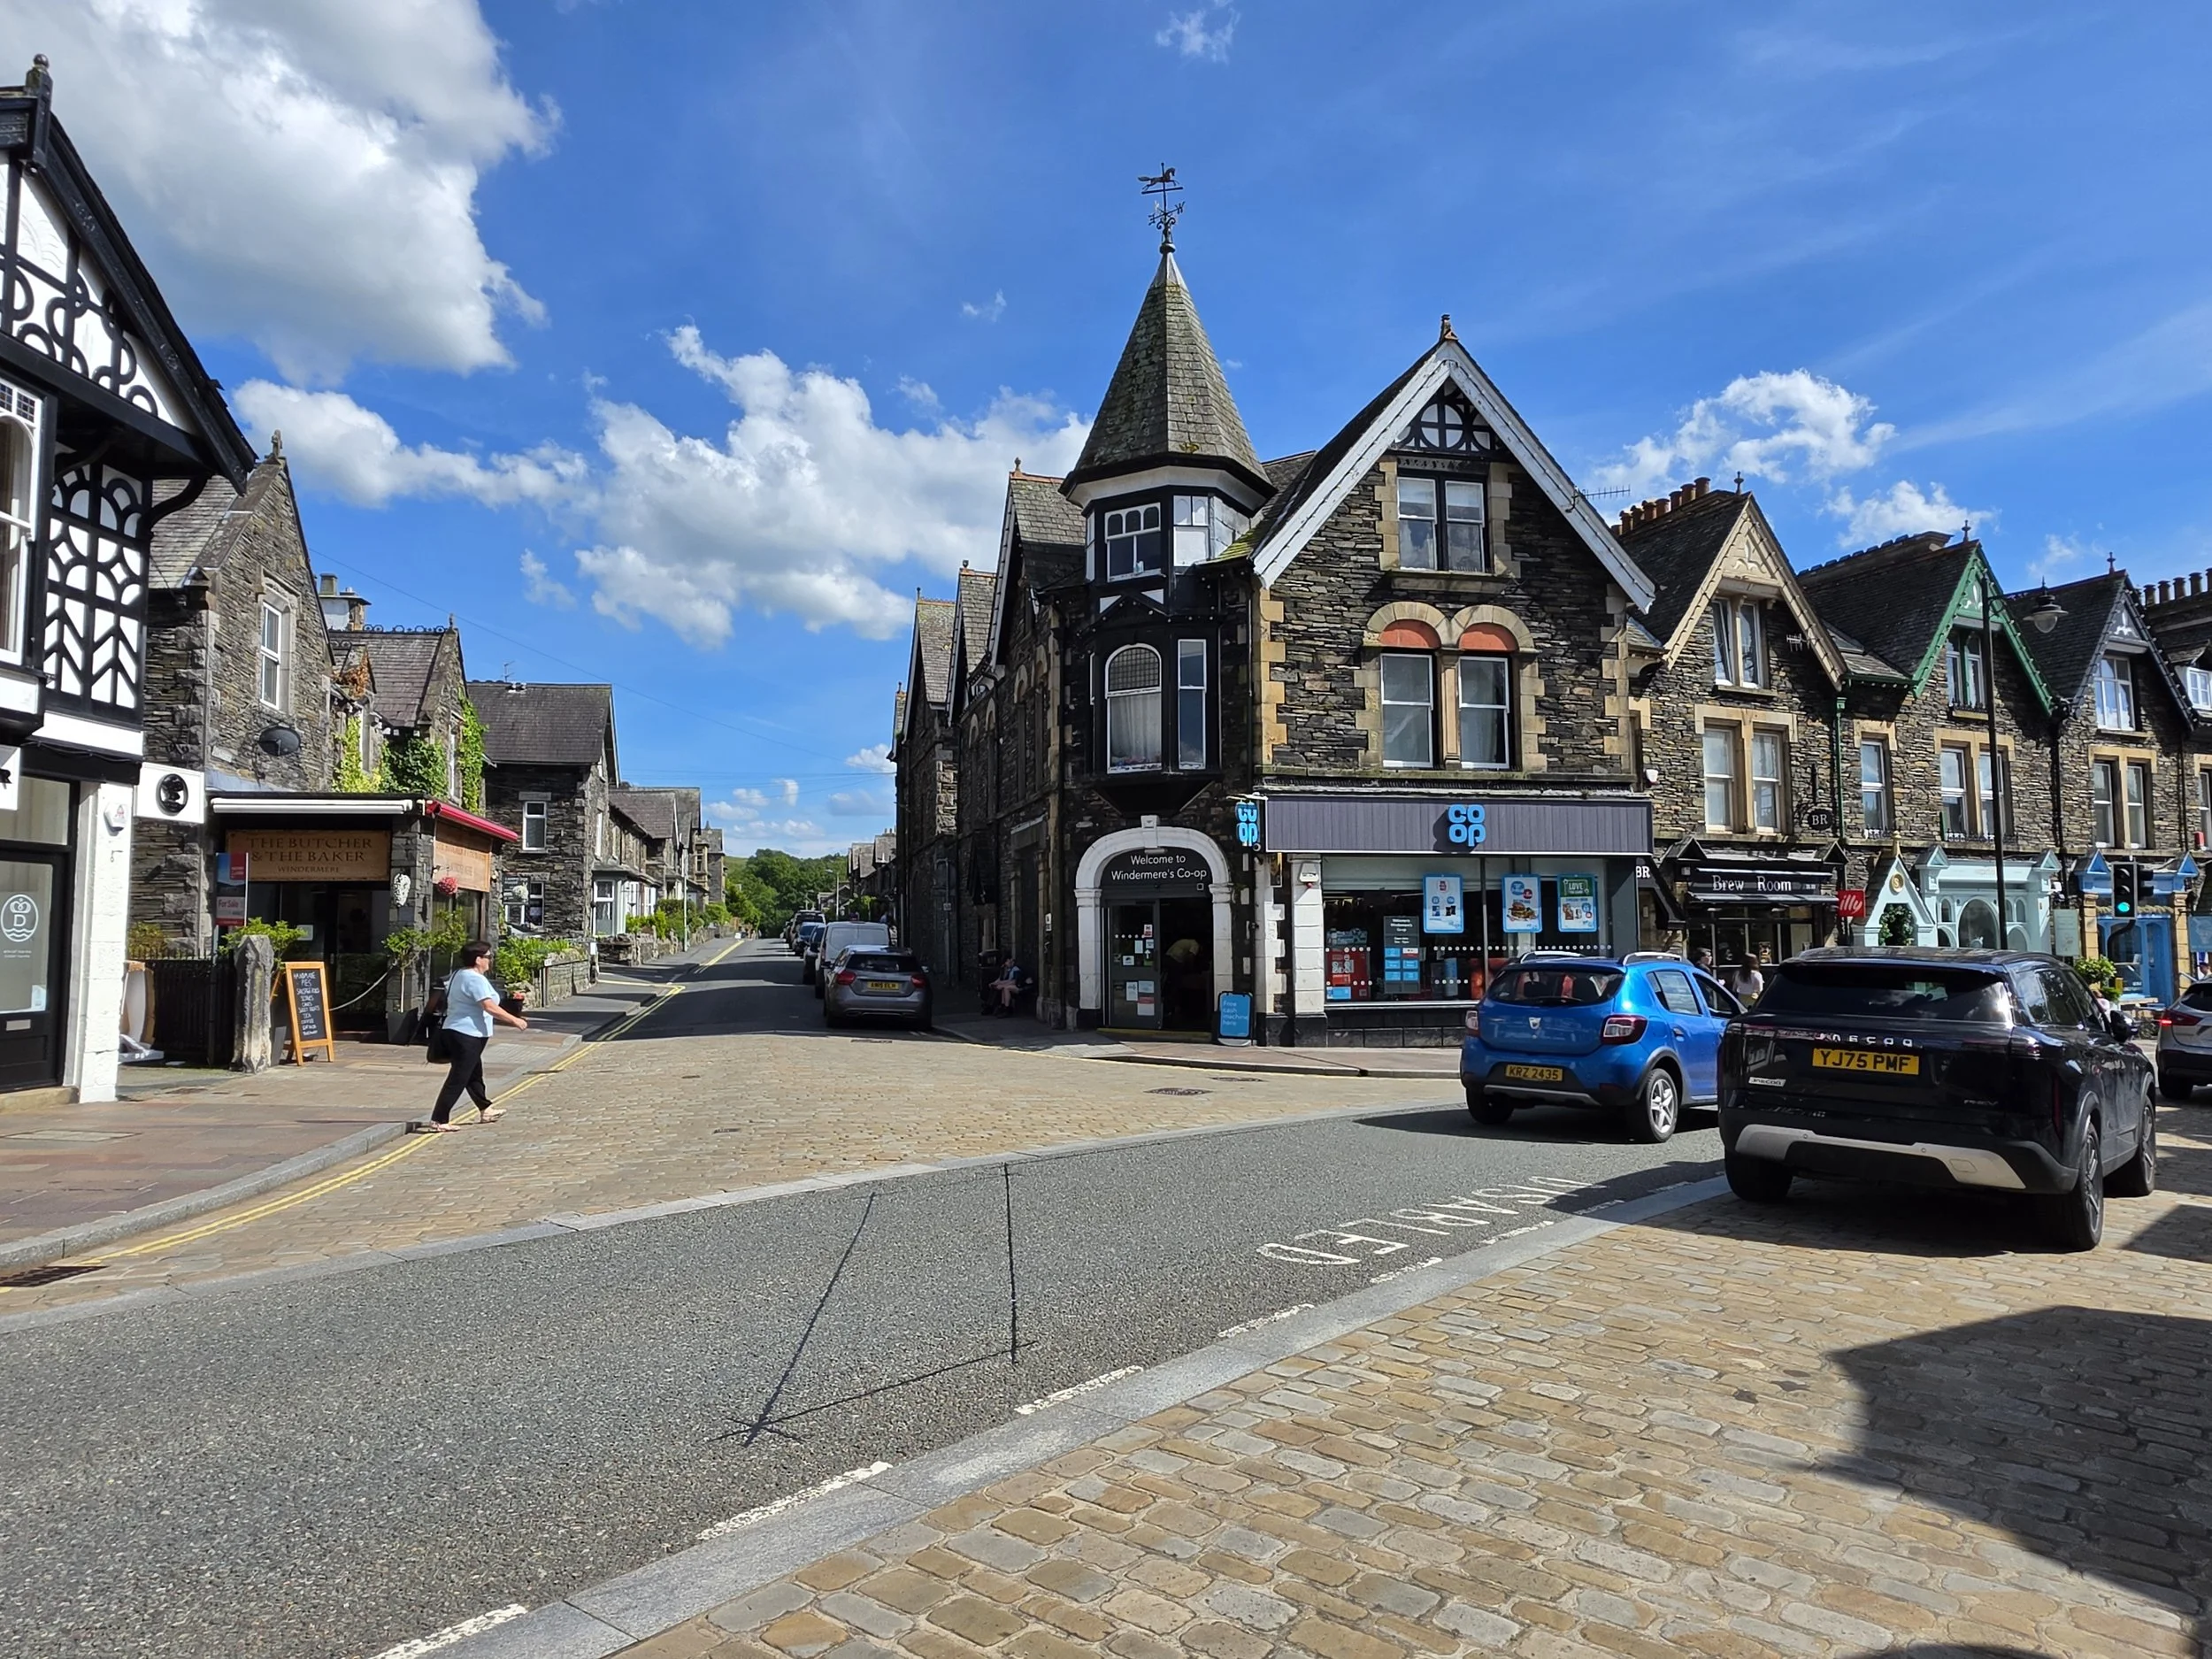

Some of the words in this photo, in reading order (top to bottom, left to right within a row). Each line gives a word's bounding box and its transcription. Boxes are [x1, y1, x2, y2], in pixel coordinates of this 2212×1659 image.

[1811, 814, 1828, 826] BR
[250, 839, 284, 849] THE
[288, 838, 373, 849] BUTCHER
[251, 852, 263, 862] &
[266, 851, 304, 862] THE
[309, 850, 365, 862] BAKER
[1130, 855, 1173, 865] Welcome
[1176, 855, 1187, 864] to
[1111, 869, 1175, 880] Windermere's
[1177, 868, 1207, 880] Co-op
[1635, 865, 1651, 879] BR
[1569, 882, 1584, 891] LOVE
[1712, 874, 1745, 892] Brew
[1756, 875, 1793, 893] Room
[1839, 894, 1863, 916] illy
[13, 914, 27, 927] D
[1820, 1050, 1868, 1069] YJ75
[1872, 1054, 1911, 1072] PMF
[1508, 1066, 1529, 1078] KRZ
[1531, 1068, 1559, 1080] 2435
[1256, 1175, 1608, 1266] DISABLED
